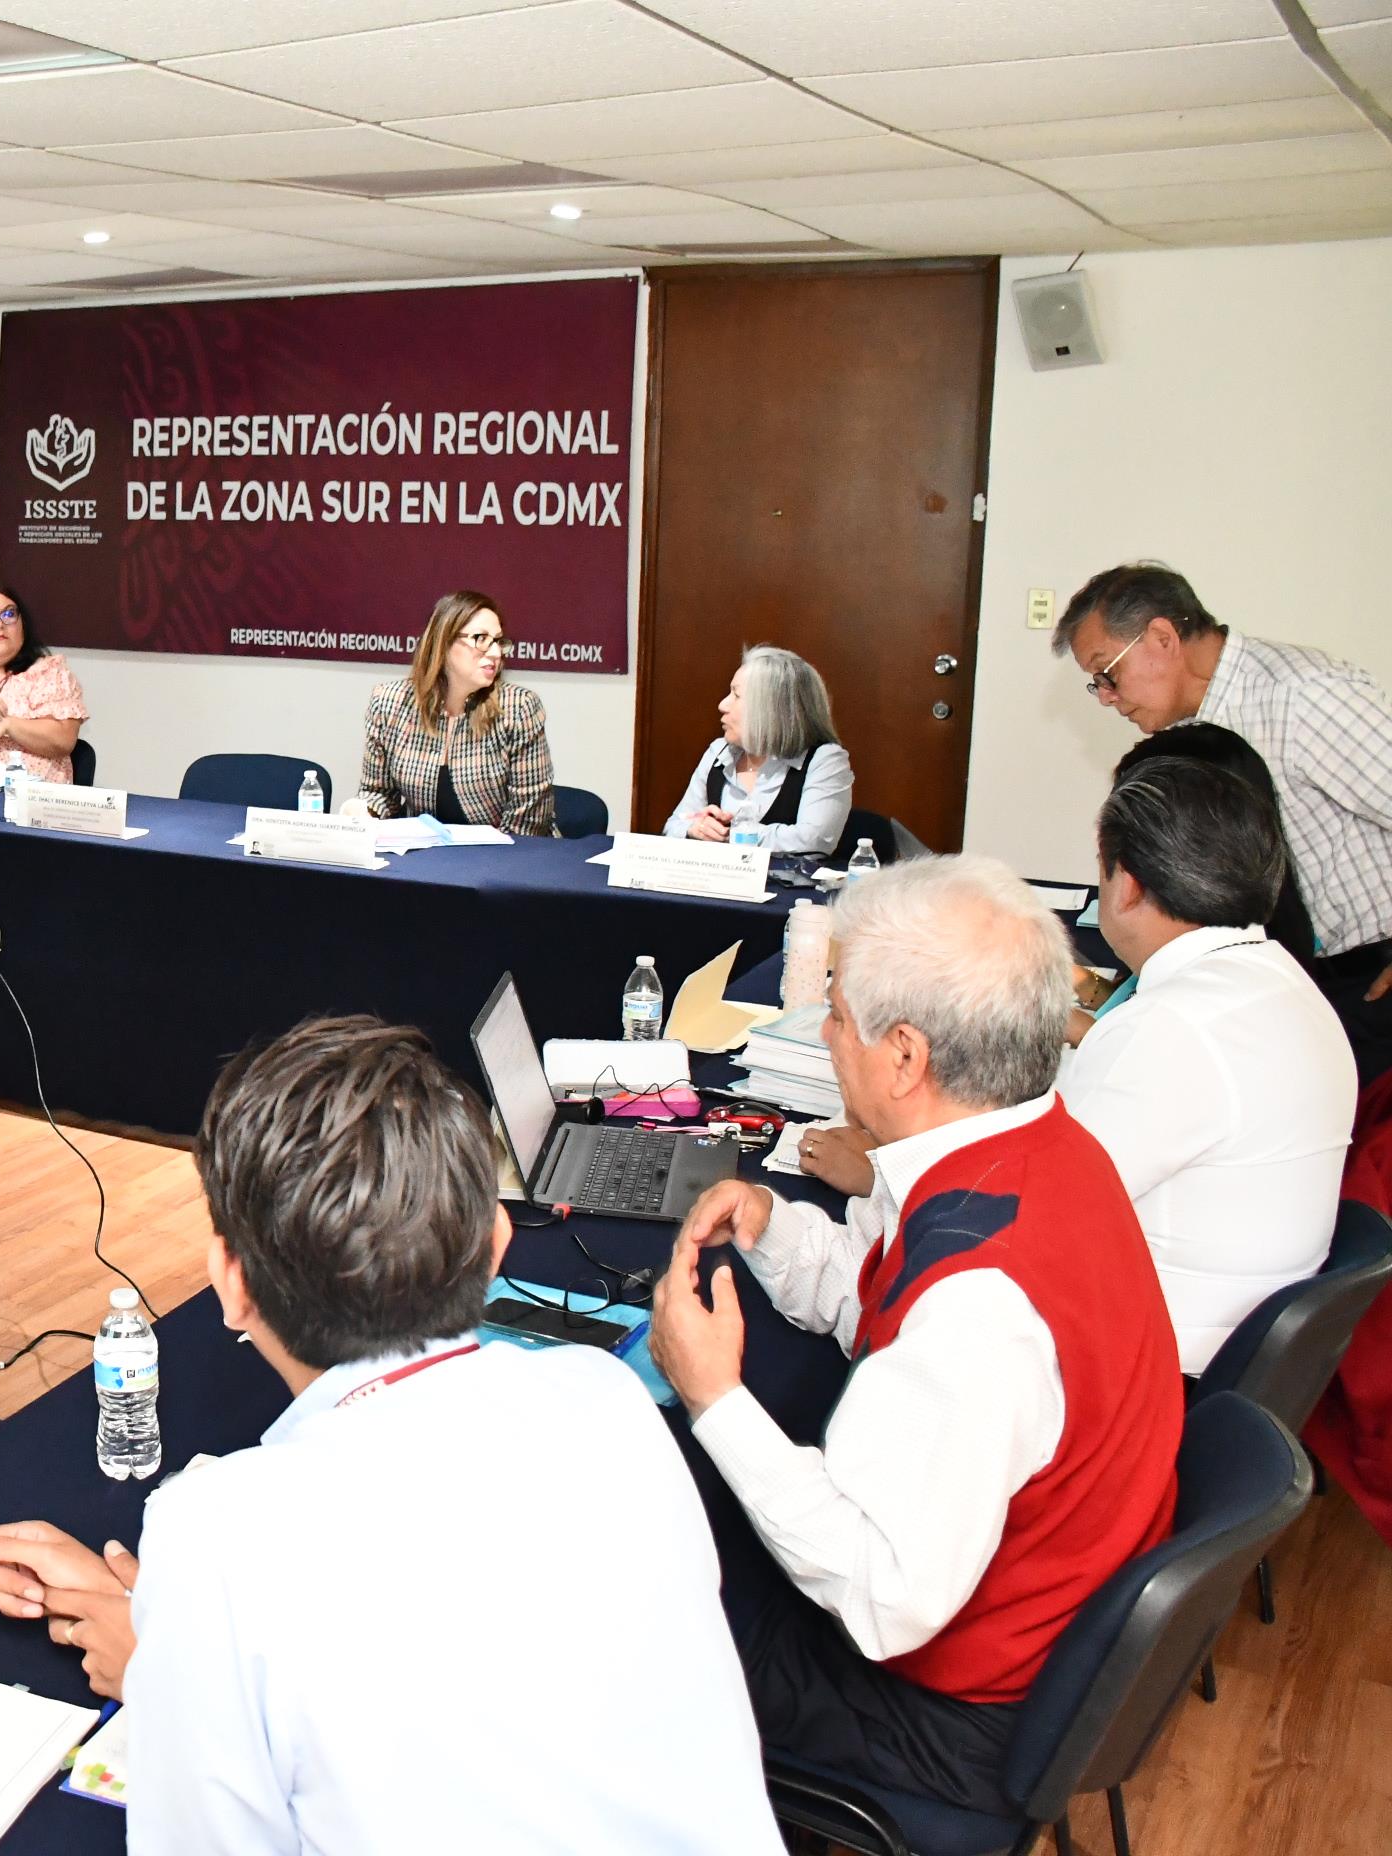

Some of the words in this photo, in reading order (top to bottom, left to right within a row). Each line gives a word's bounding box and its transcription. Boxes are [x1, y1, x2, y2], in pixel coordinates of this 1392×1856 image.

[132, 402, 423, 457] REPRESENTACIÓN
[433, 410, 619, 455] REGIONAL
[24, 499, 97, 519] ISSSTE
[126, 481, 167, 521] DE
[175, 480, 214, 521] LA
[220, 480, 314, 522] ZONA
[321, 480, 391, 523] SUR
[400, 481, 447, 524] EN
[458, 481, 504, 525] LA
[512, 481, 623, 527] CDMX
[230, 627, 337, 649] REPRESENTACIÓN
[339, 633, 404, 653] REGIONAL
[517, 641, 537, 660] EN
[539, 643, 558, 662] LA
[560, 644, 603, 664] CDMX
